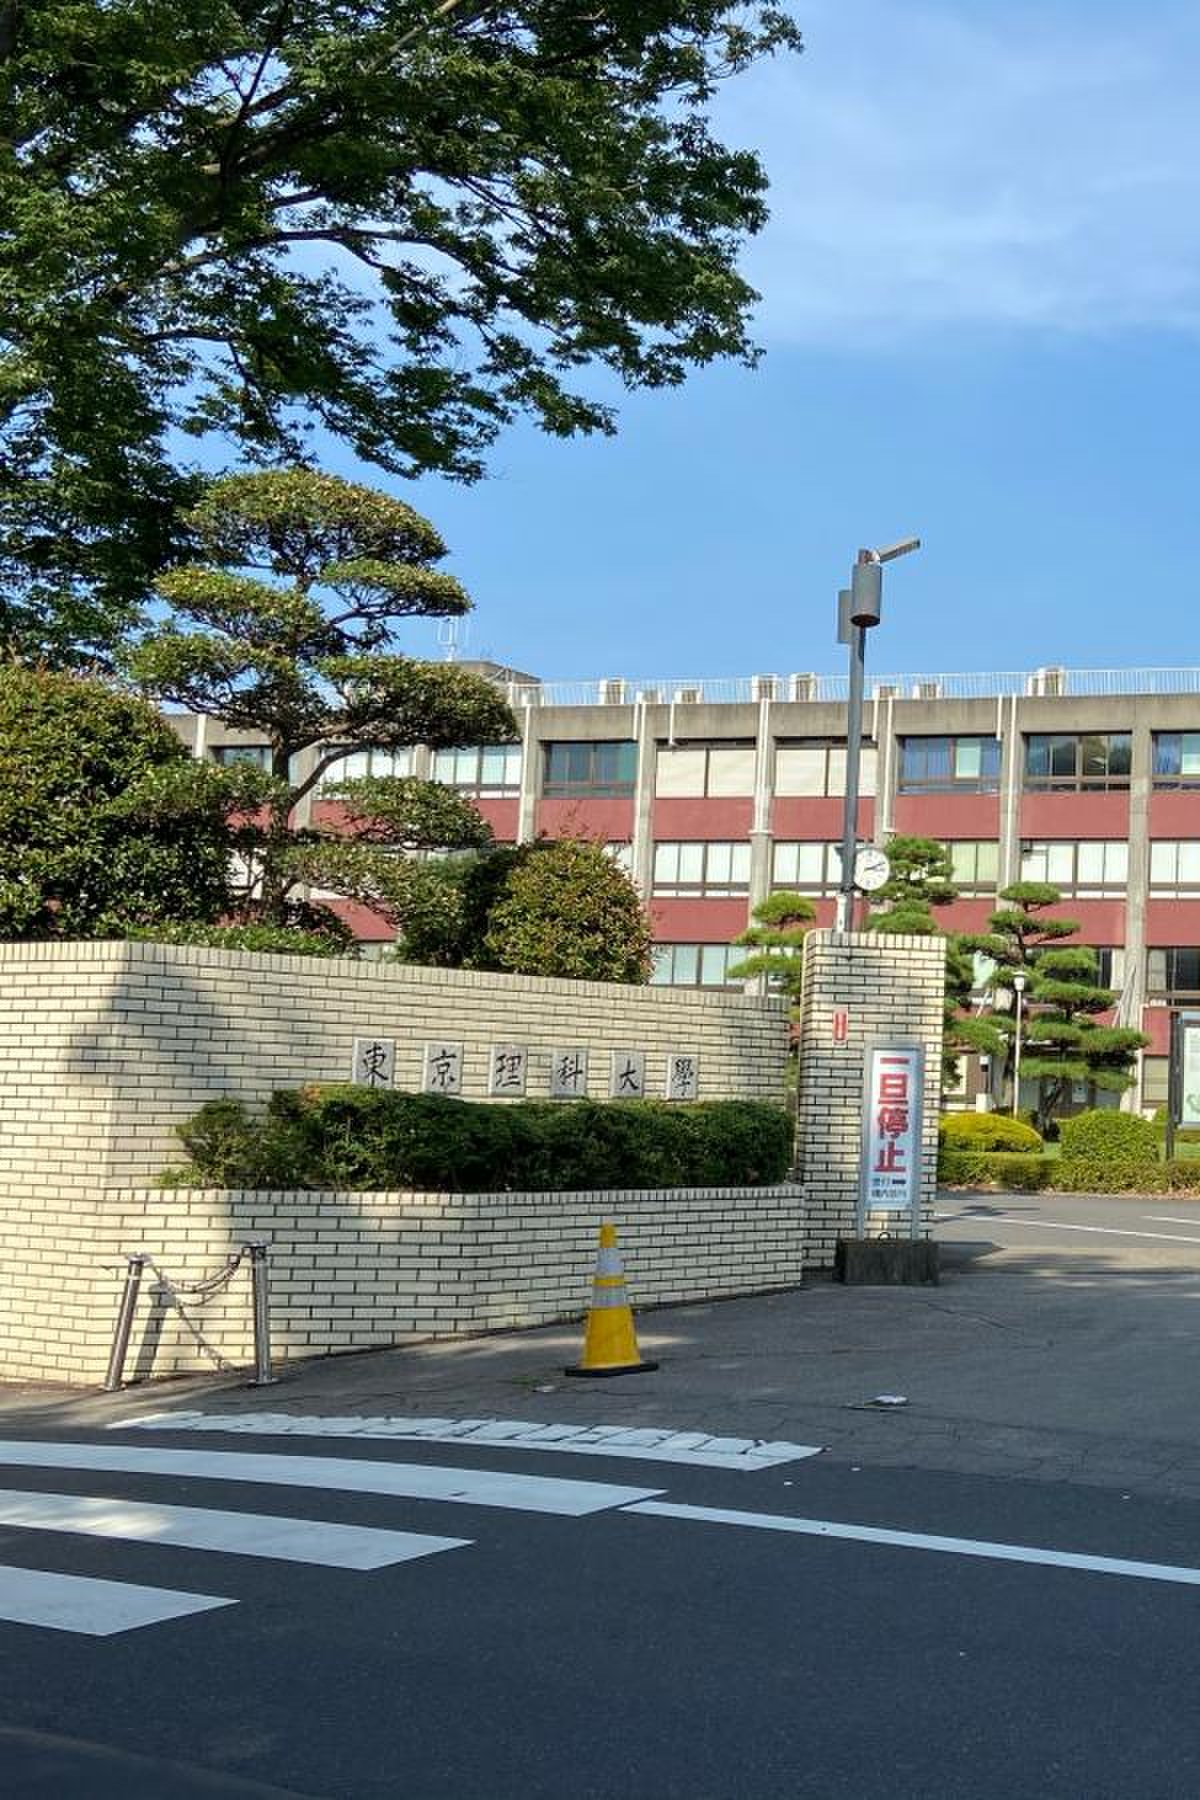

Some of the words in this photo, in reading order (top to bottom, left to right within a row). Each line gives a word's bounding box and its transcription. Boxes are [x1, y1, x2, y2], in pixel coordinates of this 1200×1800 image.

[361, 1044, 694, 1096] 東京理科大學
[874, 1056, 909, 1172] 一旦停止
